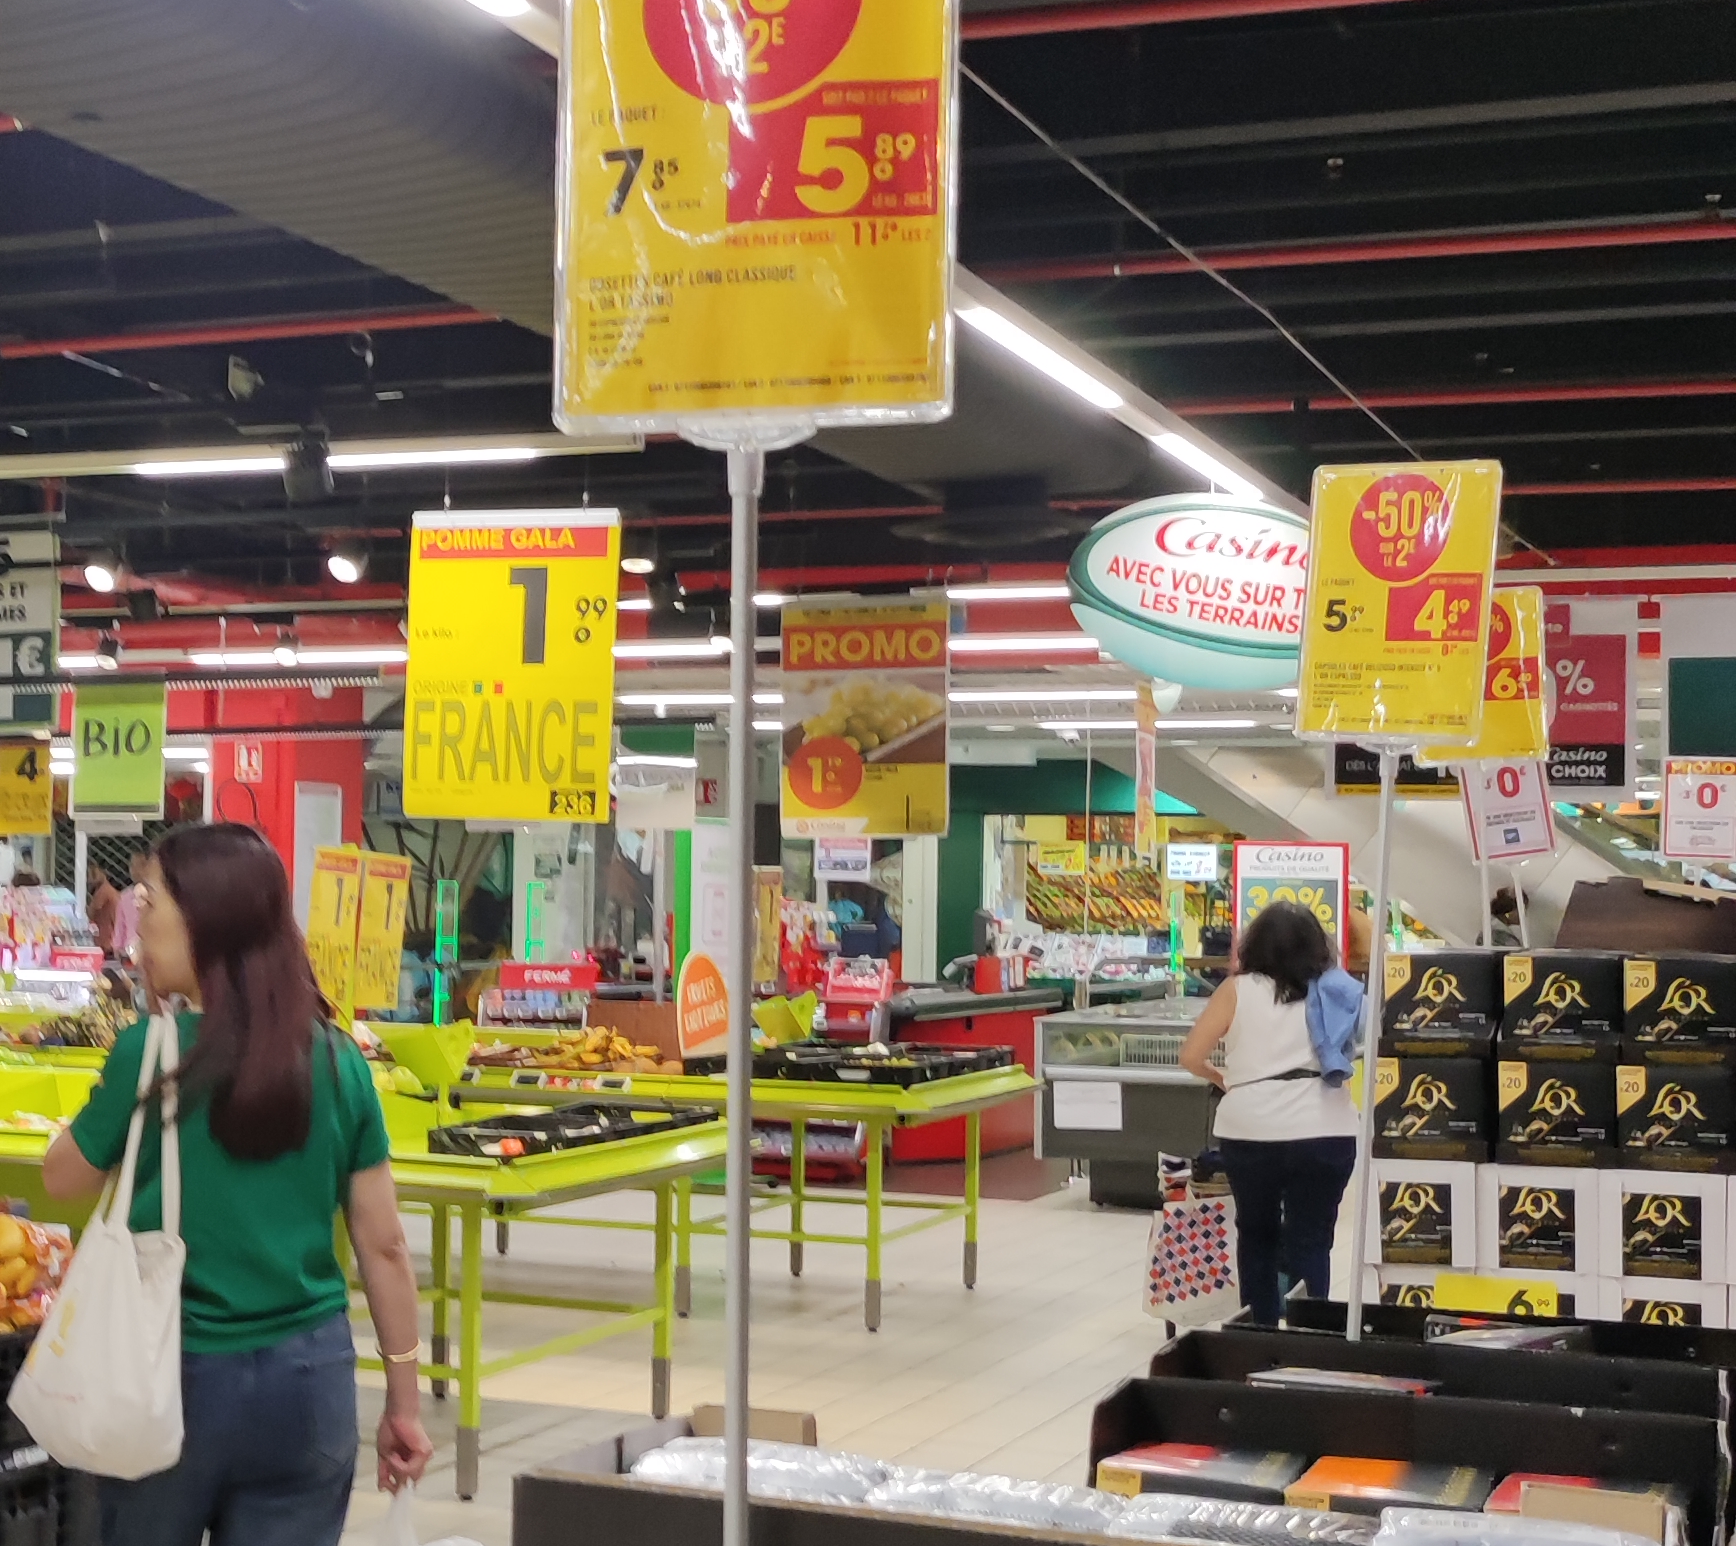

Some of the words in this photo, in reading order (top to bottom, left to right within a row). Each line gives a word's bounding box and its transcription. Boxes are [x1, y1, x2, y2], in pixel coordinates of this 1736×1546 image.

[609, 105, 657, 123] PQUET
[602, 147, 644, 216] 7
[795, 114, 870, 214] 5
[875, 133, 916, 160] 89
[725, 264, 797, 284] CLASSIQUE
[1362, 490, 1442, 538] -50%
[420, 529, 505, 552] POMME
[510, 526, 576, 550] GALA
[8, 580, 29, 600] ET
[1106, 554, 1165, 588] AVEC
[1170, 566, 1234, 602] VOUS
[1236, 580, 1287, 610] SUR
[509, 566, 548, 666] 1
[575, 597, 608, 621] 99
[1139, 588, 1180, 615] LES
[1186, 598, 1302, 635] TERRAINS
[1322, 598, 1348, 633] 5
[1413, 589, 1449, 640] 4
[789, 627, 942, 665] PROMO
[413, 679, 469, 697] ORIGINE
[1491, 667, 1518, 699] 6
[409, 697, 600, 785] FRANCE
[806, 756, 824, 794] 1
[1550, 764, 1607, 779] CHOIX
[1669, 761, 1736, 776] PROMO
[1254, 846, 1325, 863] Casino
[1506, 1289, 1535, 1315] 6
